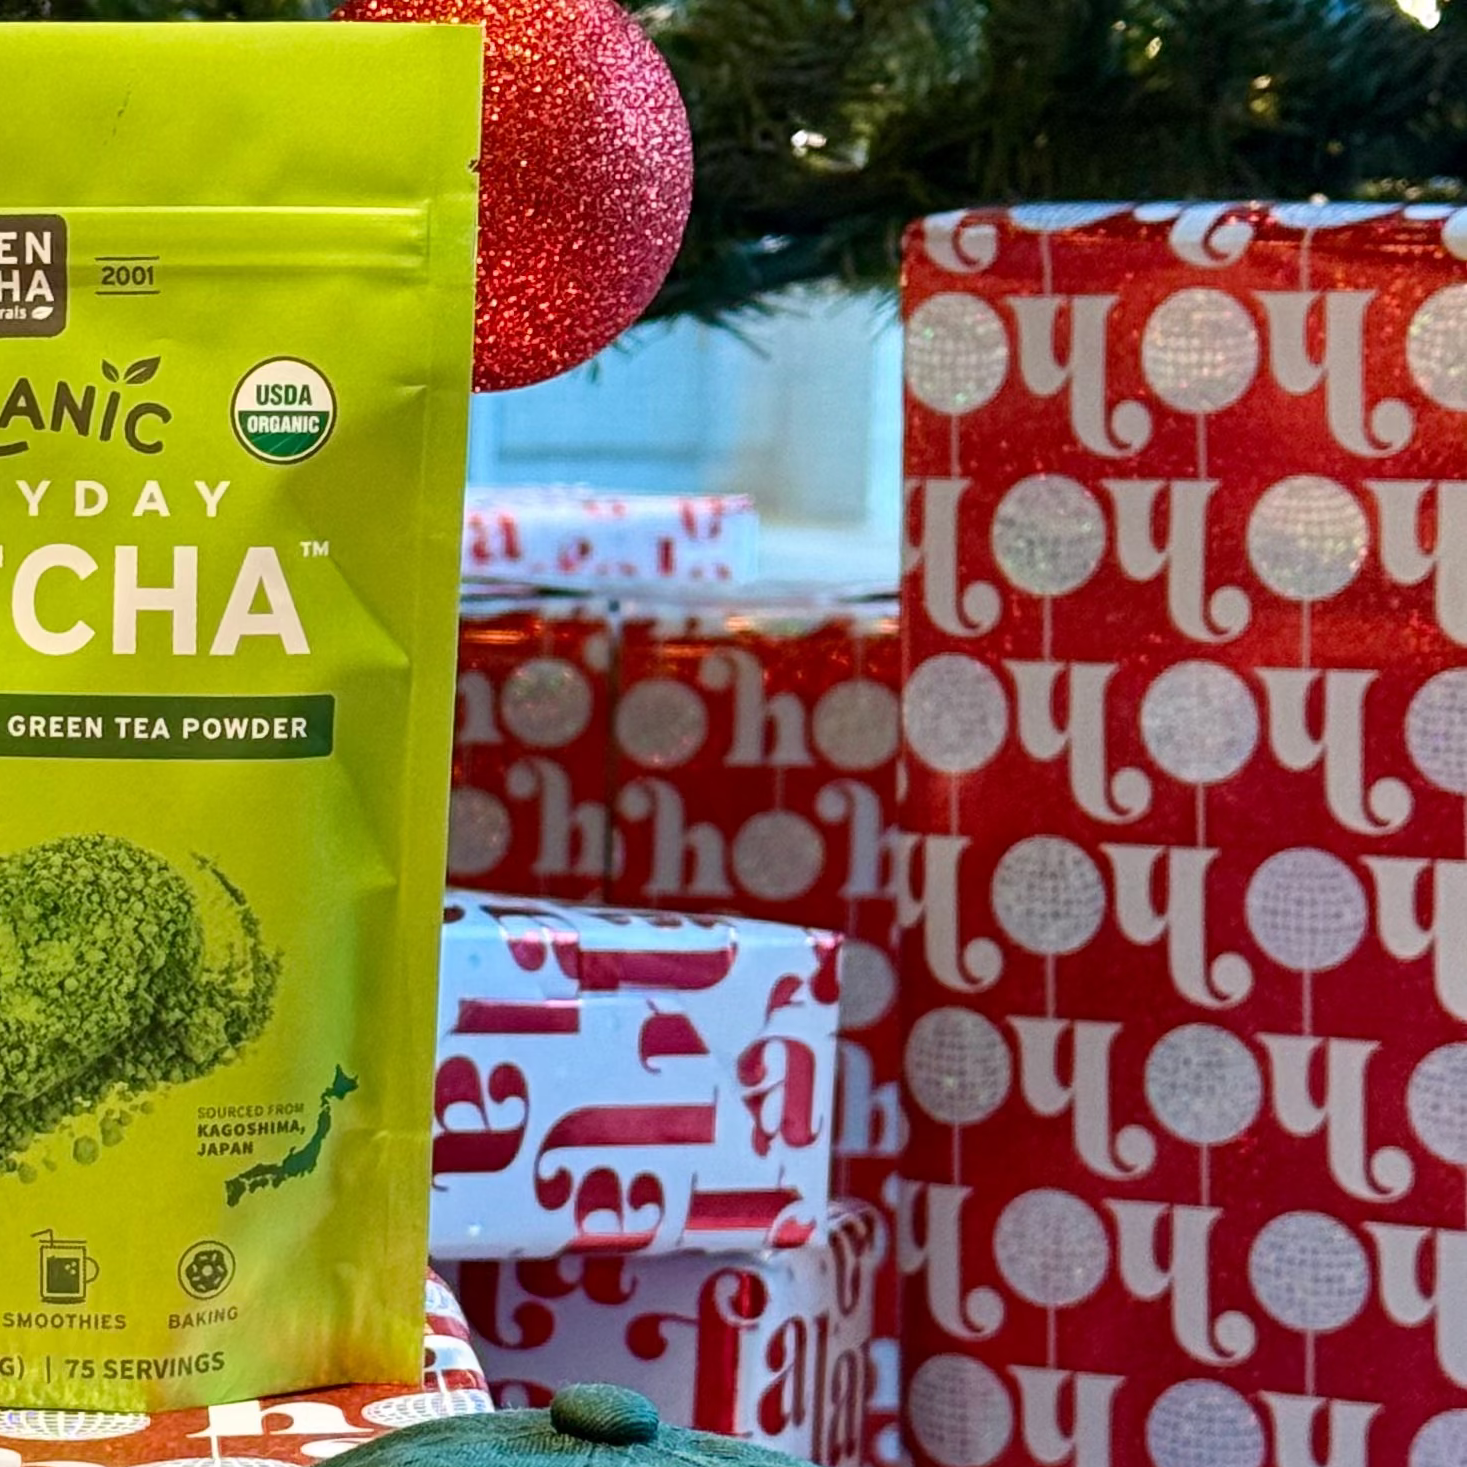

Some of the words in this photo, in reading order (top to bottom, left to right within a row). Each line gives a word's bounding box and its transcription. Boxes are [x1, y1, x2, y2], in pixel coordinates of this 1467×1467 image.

[100, 265, 156, 286] 2001
[255, 383, 313, 407] USDA
[246, 414, 321, 436] ORGANIC
[6, 714, 104, 739] GREEN
[114, 716, 172, 740] TEA
[181, 716, 309, 741] POWDER
[197, 1104, 265, 1119] SOURCED
[267, 1102, 305, 1116] FROM
[196, 1119, 306, 1138] KAGOSHIMA,
[197, 1141, 254, 1156] JAPAN
[1, 1311, 127, 1331] SMOOTHIES
[167, 1305, 239, 1331] BAKING
[64, 1358, 96, 1380] 75
[102, 1350, 226, 1381] SERVINGS
